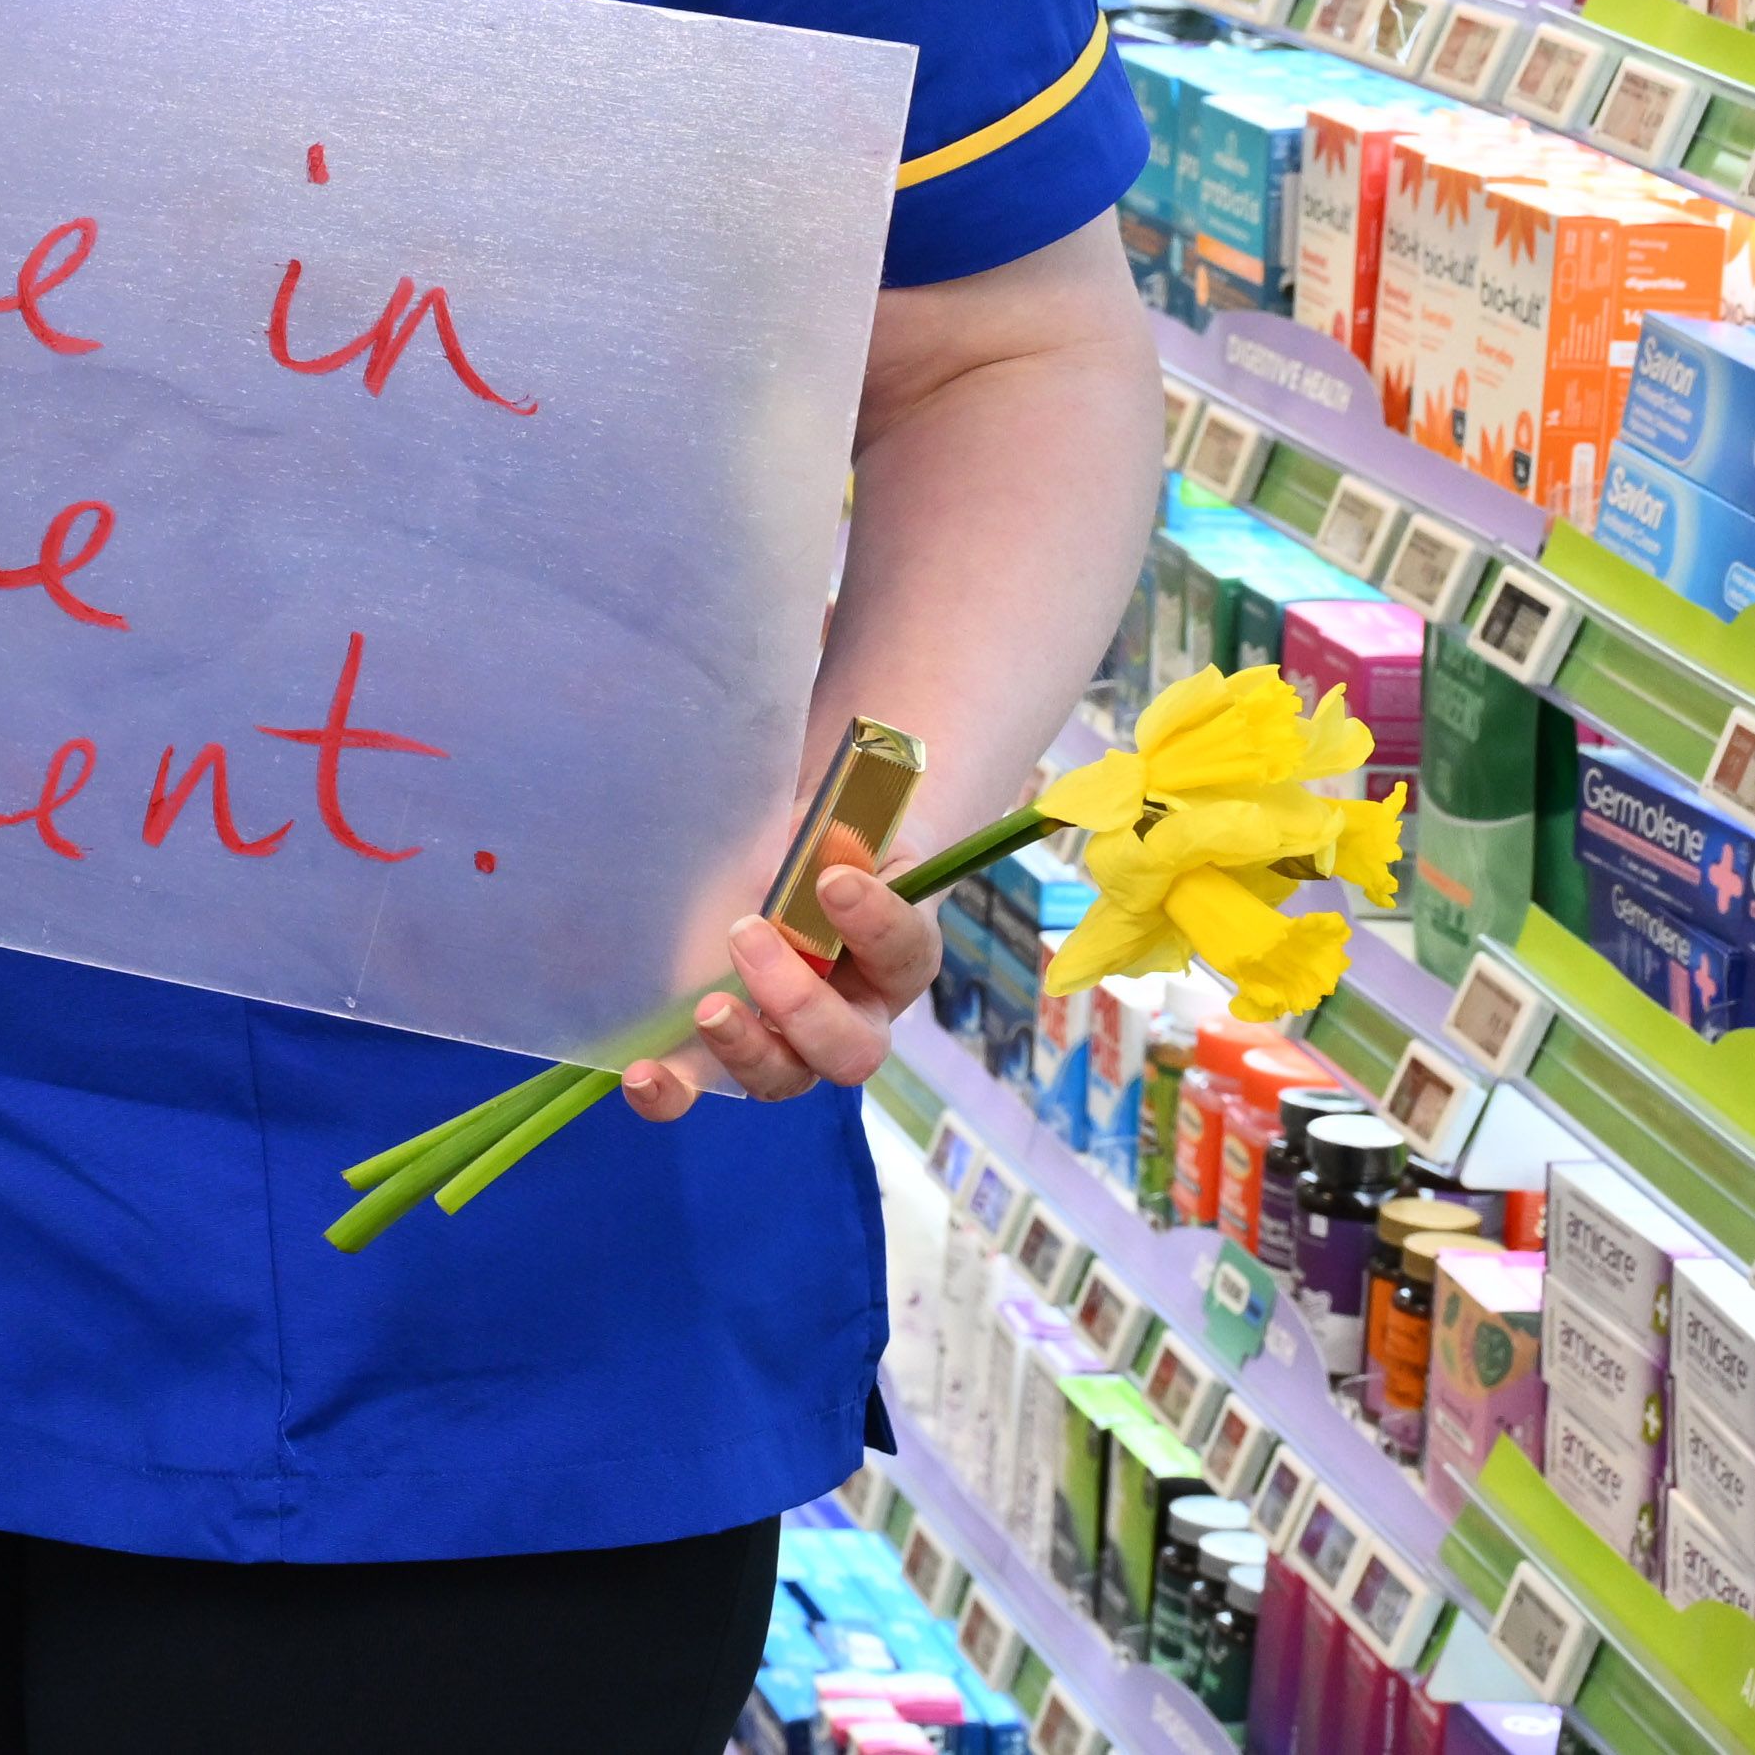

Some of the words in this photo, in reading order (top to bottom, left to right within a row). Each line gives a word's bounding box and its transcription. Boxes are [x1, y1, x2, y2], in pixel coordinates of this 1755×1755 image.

[268, 143, 537, 415] in
[1481, 275, 1547, 331] bio-kult
[1640, 335, 1697, 397] Savlon
[1607, 466, 1668, 531] Savlon
[1582, 766, 1706, 866] Germolene
[1611, 882, 1693, 968] Germolene
[1566, 1210, 1638, 1284] arnicare
[1559, 1319, 1626, 1394] arnicare
[1686, 1311, 1749, 1391] arnicare
[1562, 1425, 1624, 1503] arnicare
[1688, 1427, 1746, 1508] arnicare
